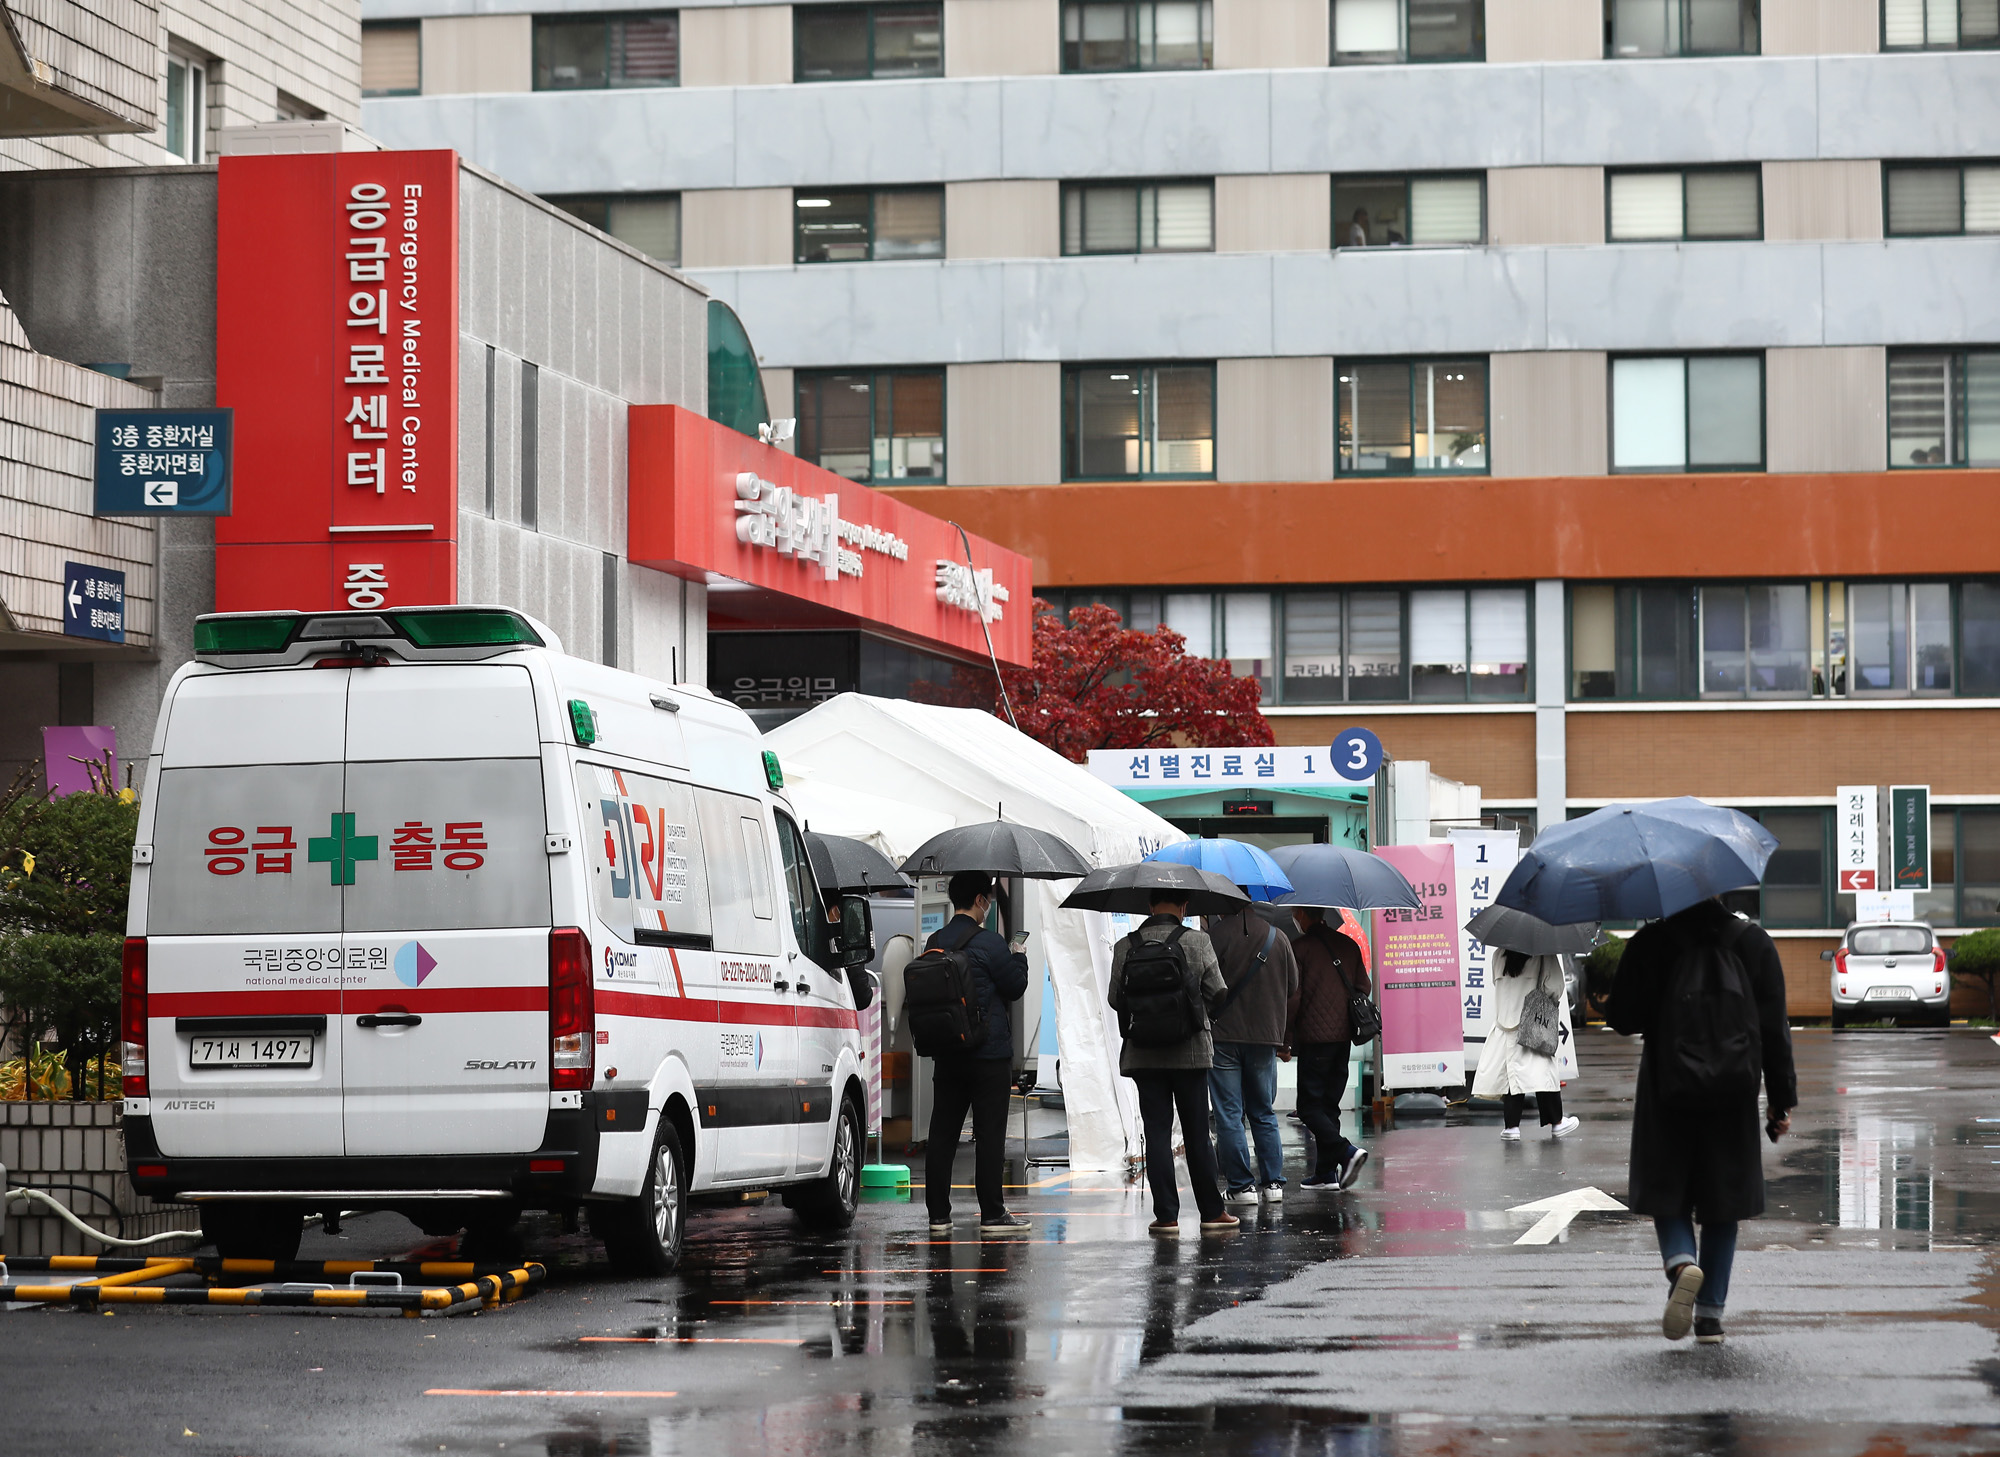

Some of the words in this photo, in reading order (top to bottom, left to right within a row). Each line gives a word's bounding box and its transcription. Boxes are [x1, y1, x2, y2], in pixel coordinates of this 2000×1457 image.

[400, 184, 422, 311] Emergency
[345, 183, 391, 494] 응급의료센터
[402, 320, 421, 408] Medical
[112, 426, 140, 448] 3층
[146, 424, 214, 448] 중환자실
[120, 453, 204, 476] 중환자면회
[402, 416, 421, 493] Center
[84, 578, 96, 599] 3층
[97, 580, 122, 603] 중환자실
[90, 608, 122, 632] 중환자면회
[1129, 752, 1276, 779] 선별진료실
[1303, 755, 1315, 774] 1
[1346, 738, 1368, 770] 3
[667, 824, 686, 838] DISASTER
[1850, 794, 1865, 864] 장례식장
[204, 826, 297, 876] 응급
[389, 821, 488, 871] 출동
[1476, 844, 1489, 863] 1
[667, 856, 688, 871] INFECTION
[666, 872, 686, 887] RESPONSE
[666, 888, 682, 903] VEHICLE
[243, 947, 388, 972] 국립중앙의료원
[246, 976, 287, 986] national
[289, 975, 331, 985] medical
[333, 976, 367, 985] center
[203, 1041, 240, 1060] 71서
[251, 1040, 301, 1060] 1497
[720, 1033, 754, 1057] 국립중앙의료원
[464, 1059, 537, 1070] SOLATI
[164, 1101, 216, 1111] AUTECH
